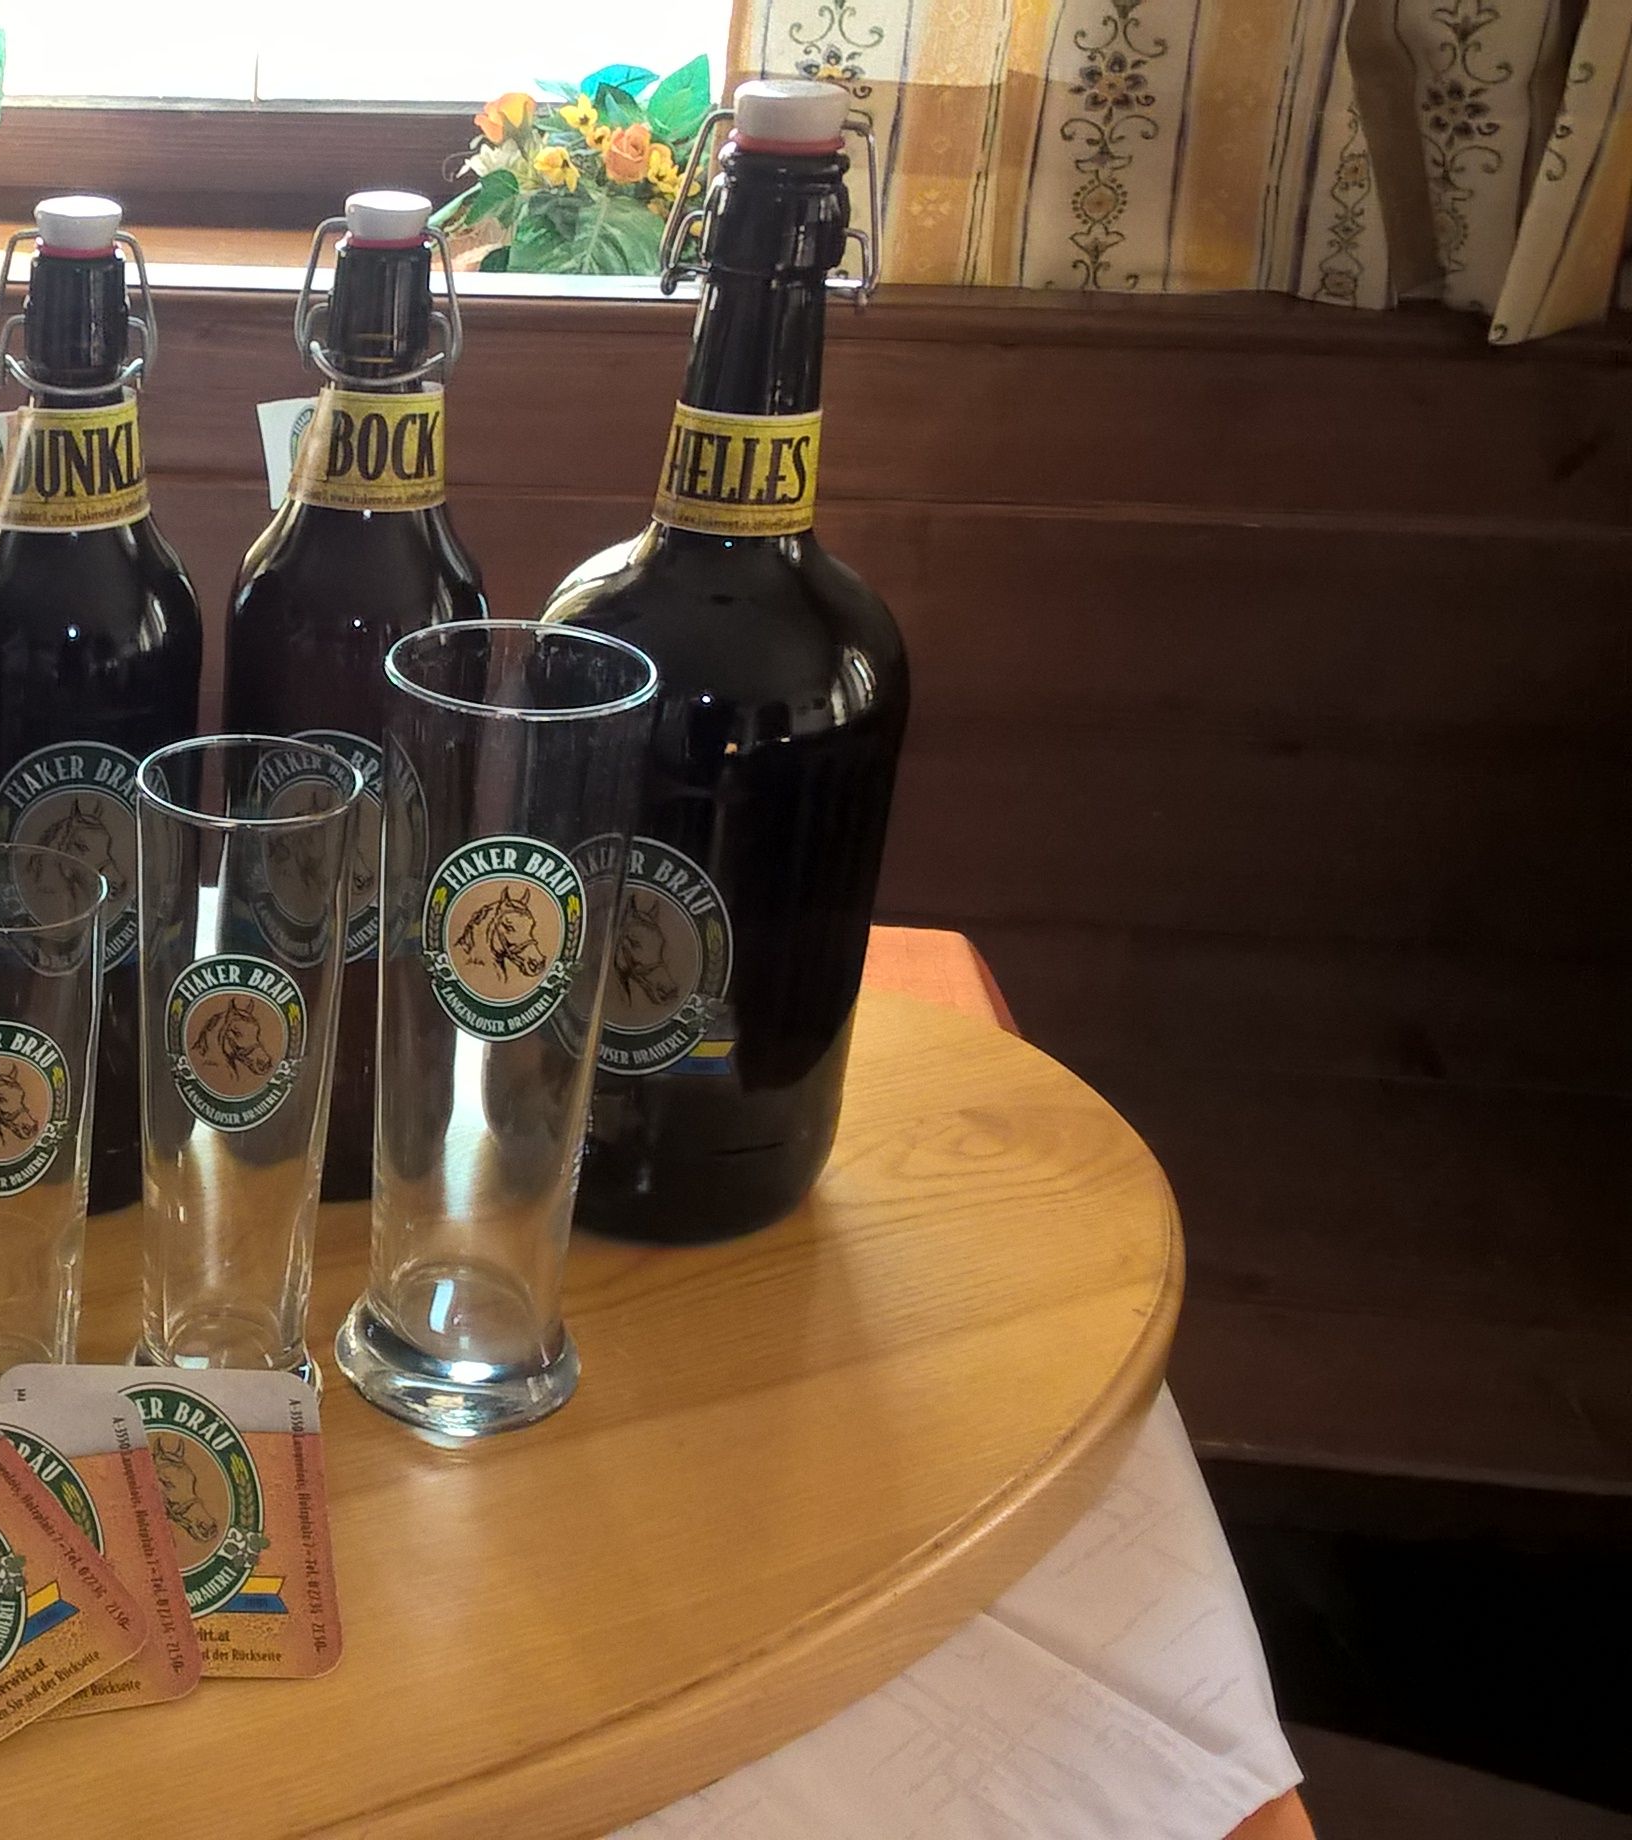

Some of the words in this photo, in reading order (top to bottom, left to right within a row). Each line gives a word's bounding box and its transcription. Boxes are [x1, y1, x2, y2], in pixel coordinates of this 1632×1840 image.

[326, 409, 440, 481] BOCK
[666, 425, 811, 505] HELLES
[3, 755, 85, 809] FIAKER
[442, 848, 518, 891] FIAKER
[523, 852, 577, 898] BRÄU
[653, 859, 716, 915] BRÄU
[177, 965, 241, 1001] FIAKER
[247, 968, 296, 1005] BRÄU
[441, 986, 506, 1034] LANGENLOISER
[507, 993, 554, 1032] BRAUEREI
[10, 1032, 58, 1069] BRÄU
[631, 1028, 690, 1065] BRAUEREI
[182, 1085, 241, 1124] LANGENLOISER
[242, 1088, 282, 1122] BRAUEREI
[10, 1151, 50, 1186] BRAUEREI
[174, 1400, 237, 1452] BRÄU
[186, 1565, 237, 1606] BRAUEREI
[232, 1646, 283, 1662] Rückseite
[7, 1695, 25, 1714] Sie
[24, 1687, 41, 1704] auf
[40, 1679, 58, 1696] der
[55, 1650, 101, 1685] Rückseite
[90, 1679, 142, 1698] Rückseite
